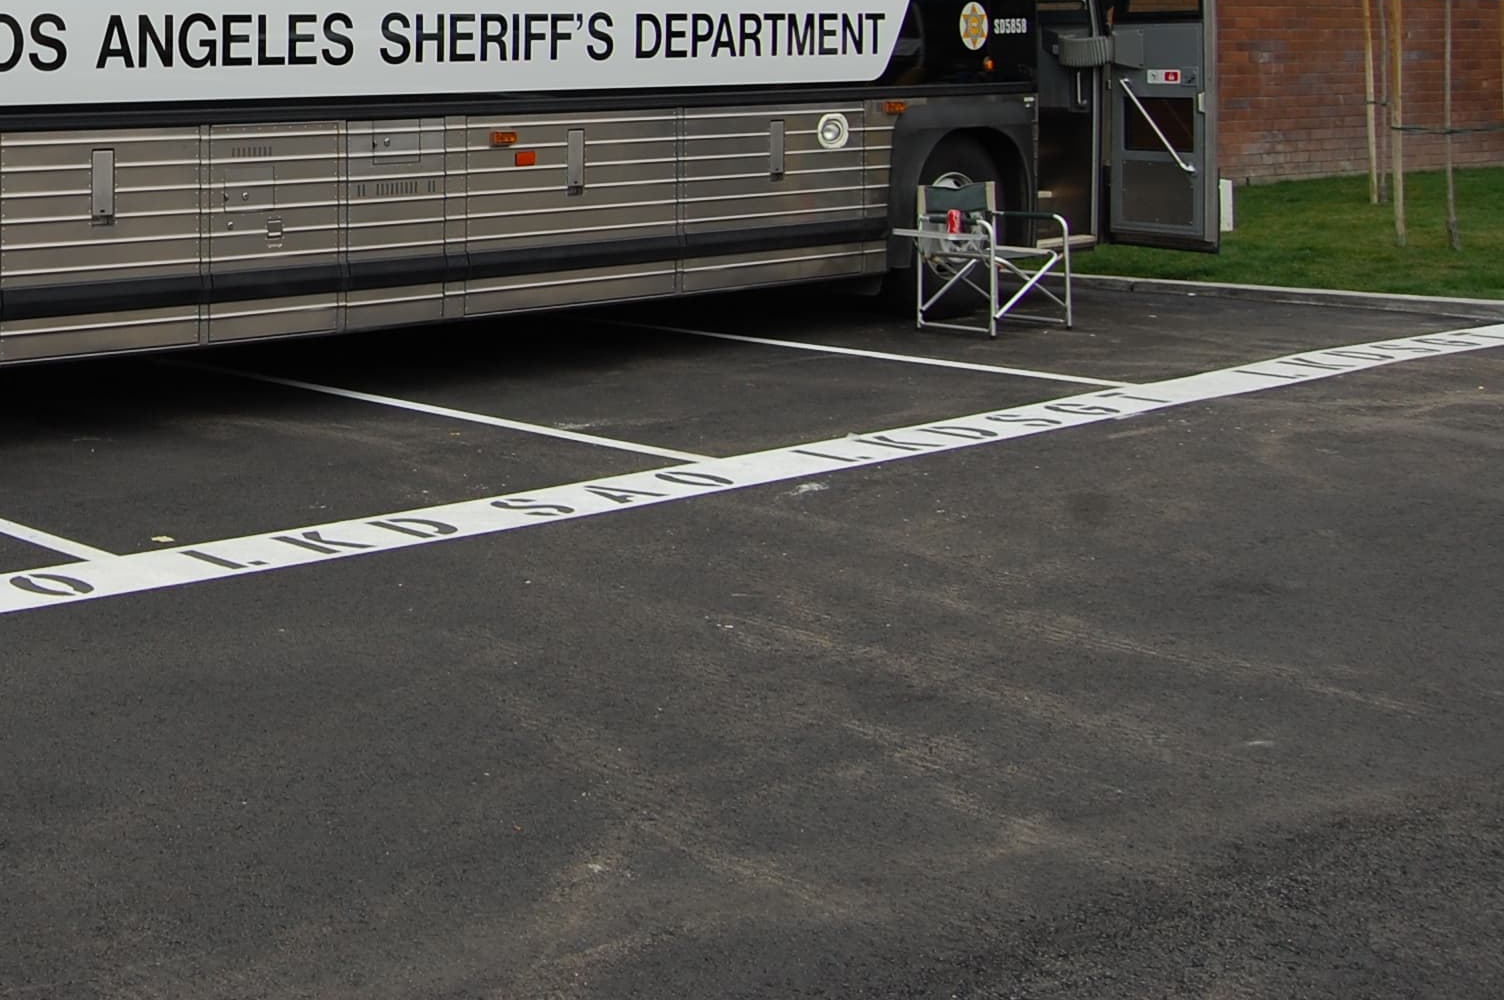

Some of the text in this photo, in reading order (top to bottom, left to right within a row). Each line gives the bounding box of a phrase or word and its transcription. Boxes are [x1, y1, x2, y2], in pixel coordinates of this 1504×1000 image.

[95, 12, 354, 69] ANGELES
[379, 11, 614, 65] SHERIFF'S
[635, 12, 886, 59] DEPARTMENT
[993, 18, 1028, 34] SD5858
